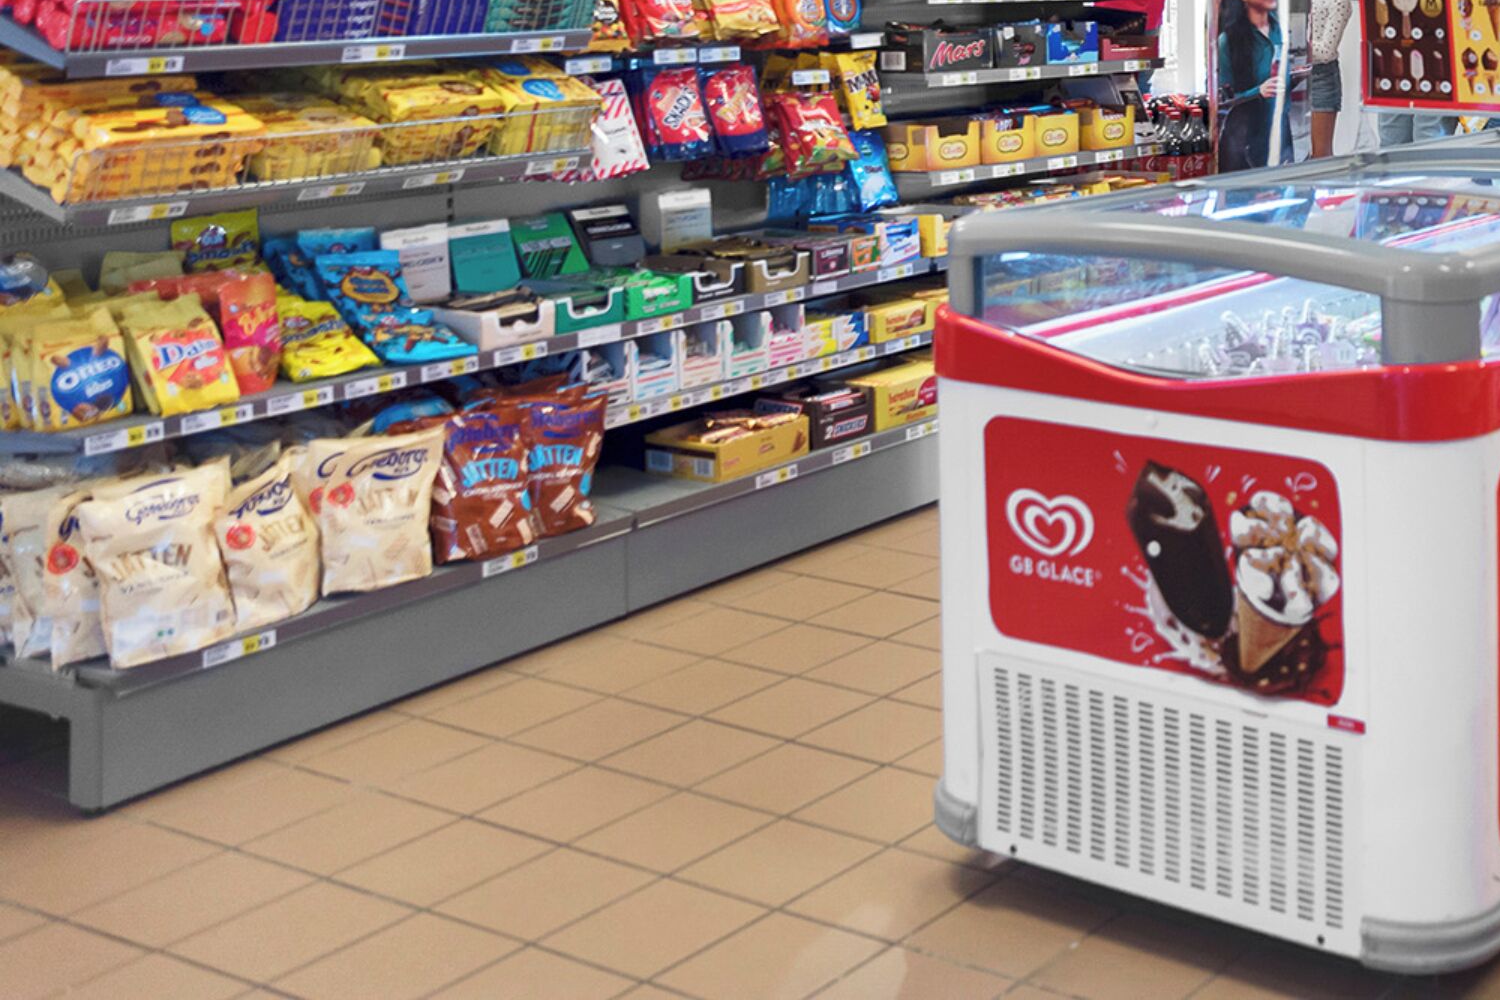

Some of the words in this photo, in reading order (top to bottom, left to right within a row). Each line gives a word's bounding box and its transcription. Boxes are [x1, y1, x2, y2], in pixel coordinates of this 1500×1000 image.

[930, 39, 985, 69] Mars
[157, 338, 219, 371] Daim
[57, 355, 121, 390] OREO
[1010, 555, 1034, 576] GB
[1036, 560, 1095, 588] GLACE
